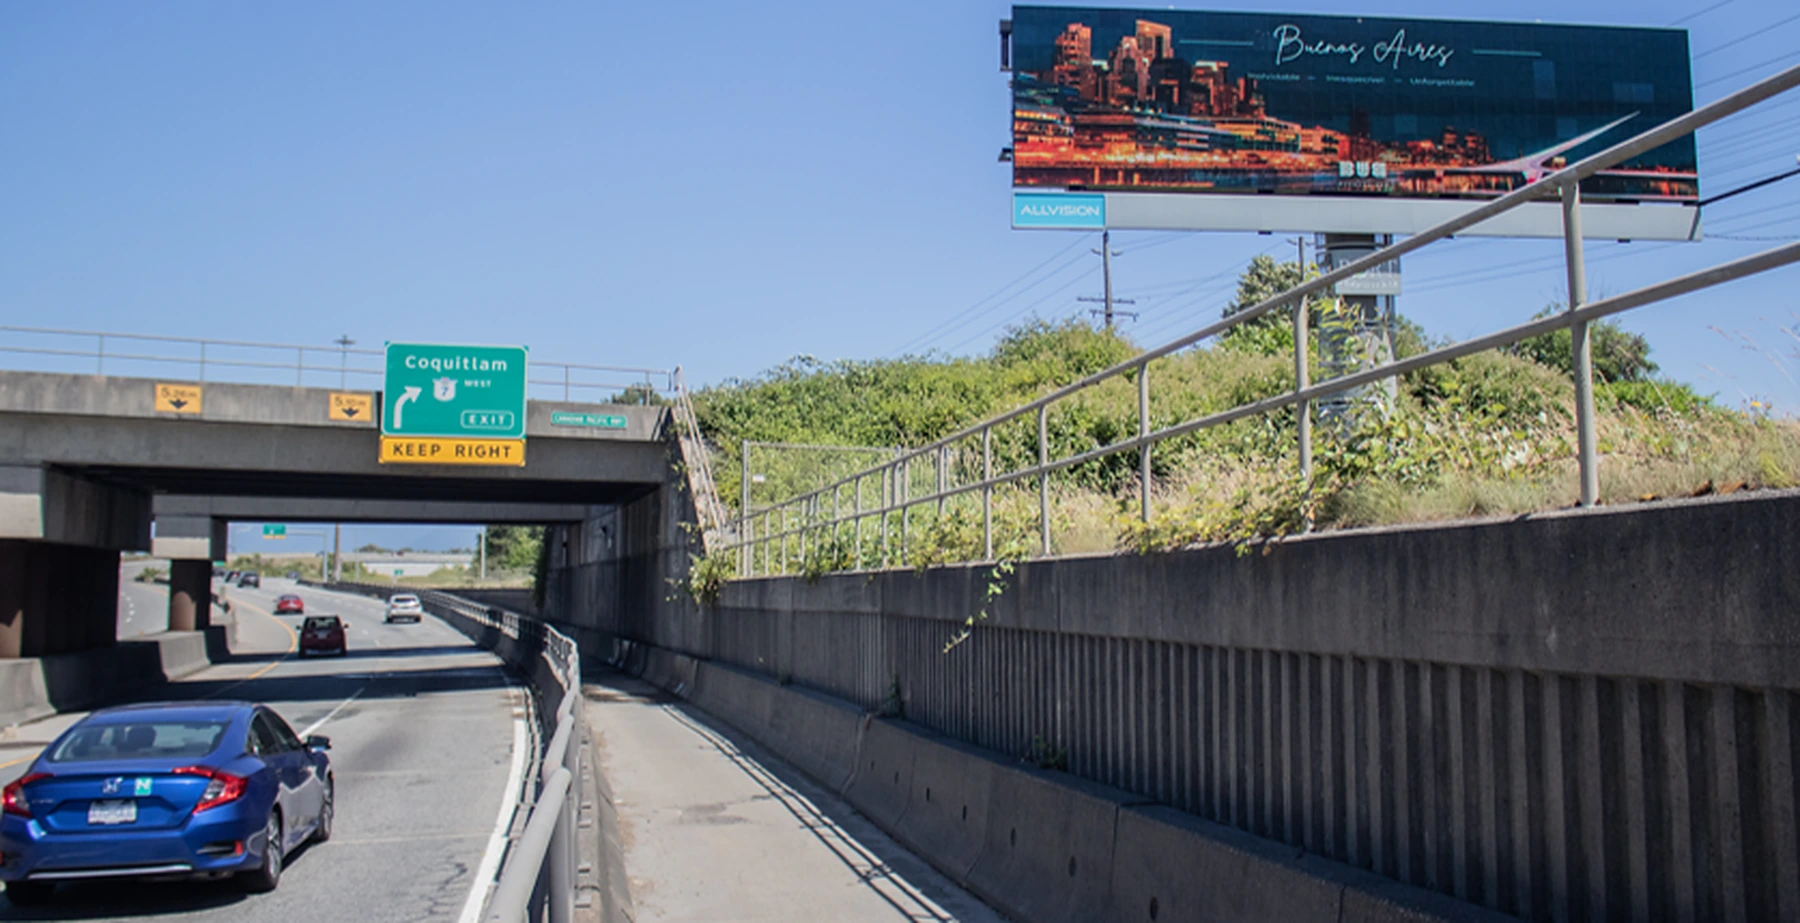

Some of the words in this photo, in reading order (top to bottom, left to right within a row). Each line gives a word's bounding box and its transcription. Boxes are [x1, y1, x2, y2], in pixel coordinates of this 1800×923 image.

[1273, 24, 1365, 65] Buenos
[1373, 28, 1453, 69] Aires
[1020, 204, 1100, 216] ALLVISION
[405, 355, 507, 372] Coquitlam
[441, 386, 449, 397] 7
[464, 379, 492, 387] WEST
[469, 415, 506, 425] EXIT
[393, 443, 441, 456] KEEP
[455, 444, 511, 458] RIGHT
[136, 778, 149, 791] N
